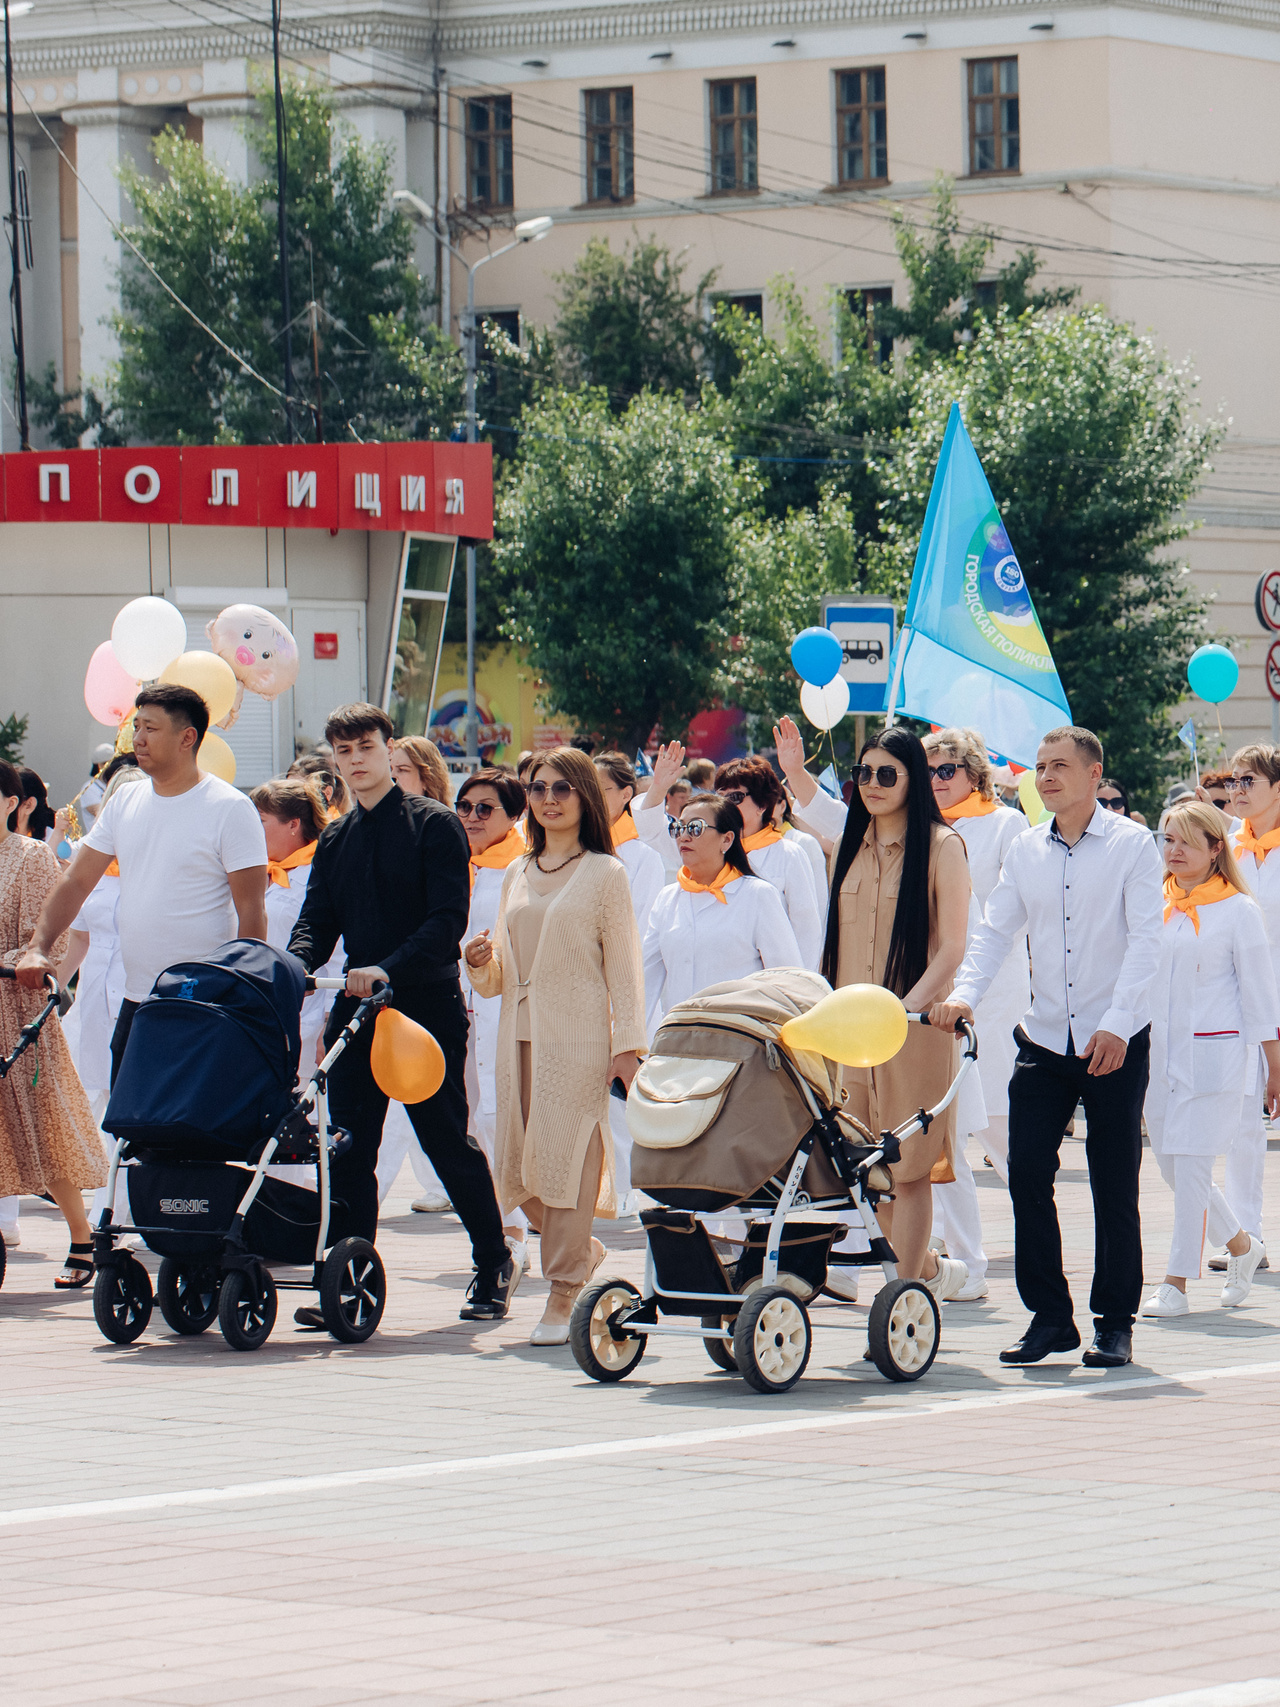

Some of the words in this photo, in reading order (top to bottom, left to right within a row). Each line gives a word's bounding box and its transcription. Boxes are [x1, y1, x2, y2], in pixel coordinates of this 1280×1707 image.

[38, 463, 465, 517] ПОЛИЦИЯ
[1005, 565, 1020, 579] ISO
[964, 553, 998, 639] ГОРОДСКАЯ
[160, 1198, 210, 1213] SONIC
